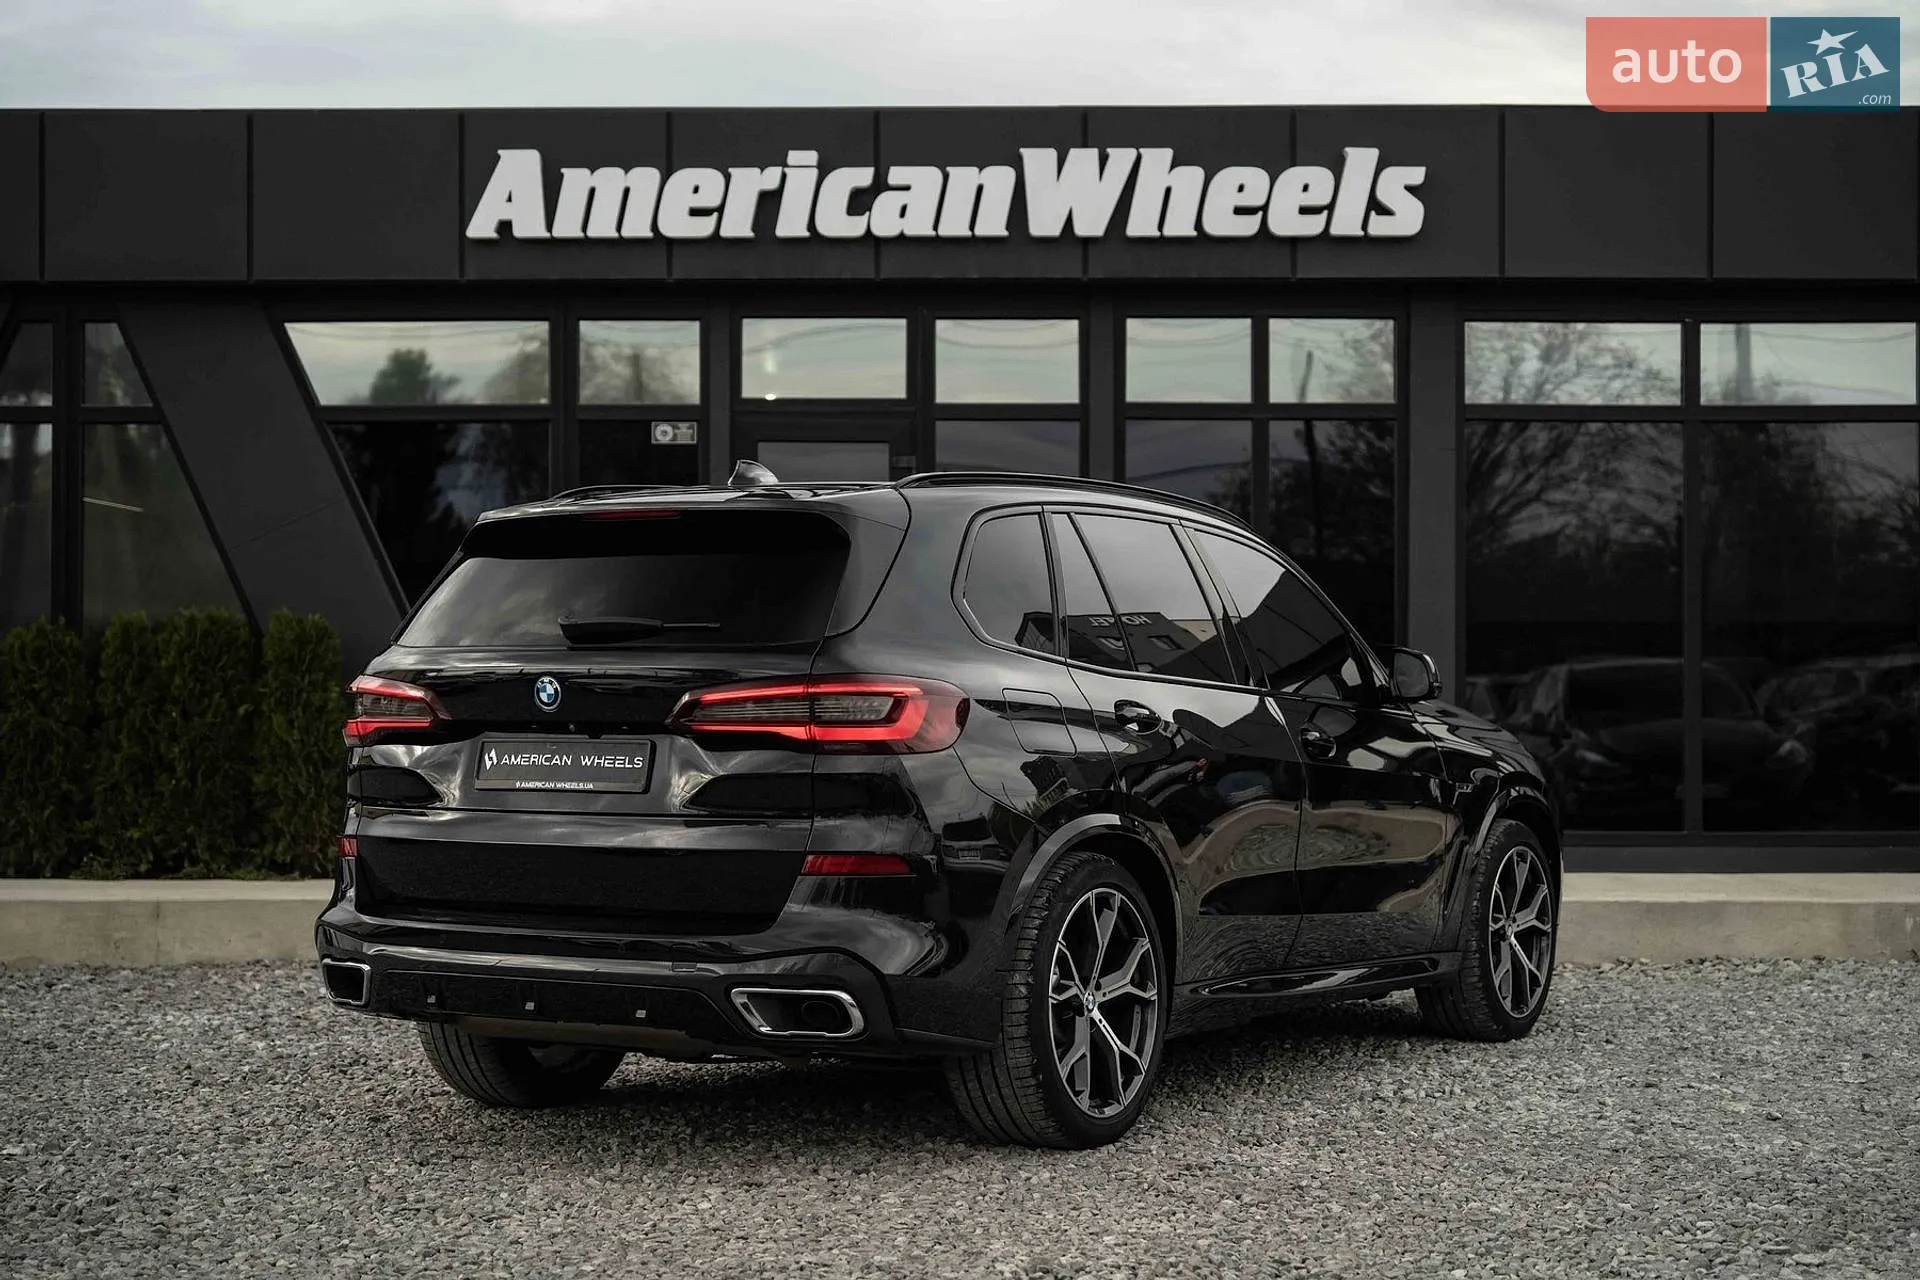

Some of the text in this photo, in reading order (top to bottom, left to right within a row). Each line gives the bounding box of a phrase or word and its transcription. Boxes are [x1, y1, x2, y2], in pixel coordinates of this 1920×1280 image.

[465, 147, 1428, 239] AmericanWheels
[500, 754, 643, 768] AMERICAN WHEELS
[520, 781, 554, 789] AMERICAN
